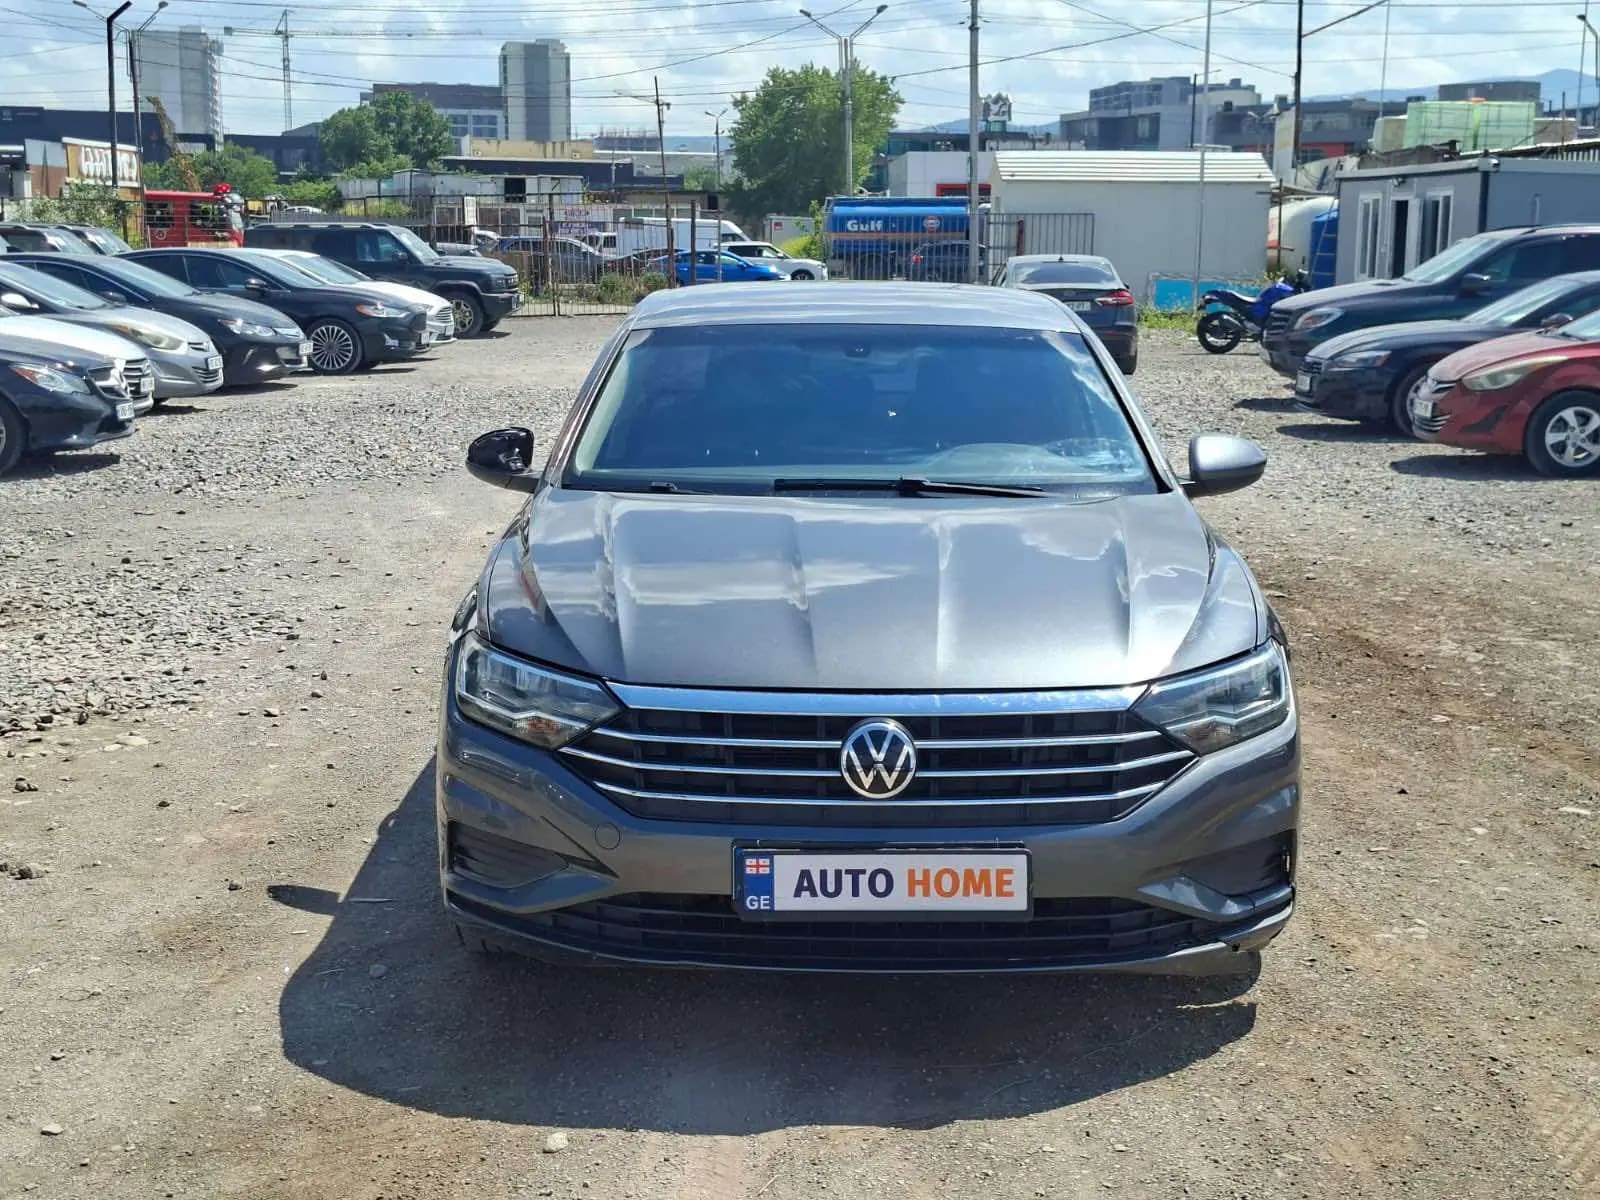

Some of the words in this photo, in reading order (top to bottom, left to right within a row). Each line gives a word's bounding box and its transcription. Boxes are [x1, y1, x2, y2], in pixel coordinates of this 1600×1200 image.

[846, 219, 883, 232] Gulf
[793, 868, 894, 898] AUTO
[907, 868, 1015, 898] HOME
[746, 895, 771, 911] GE
